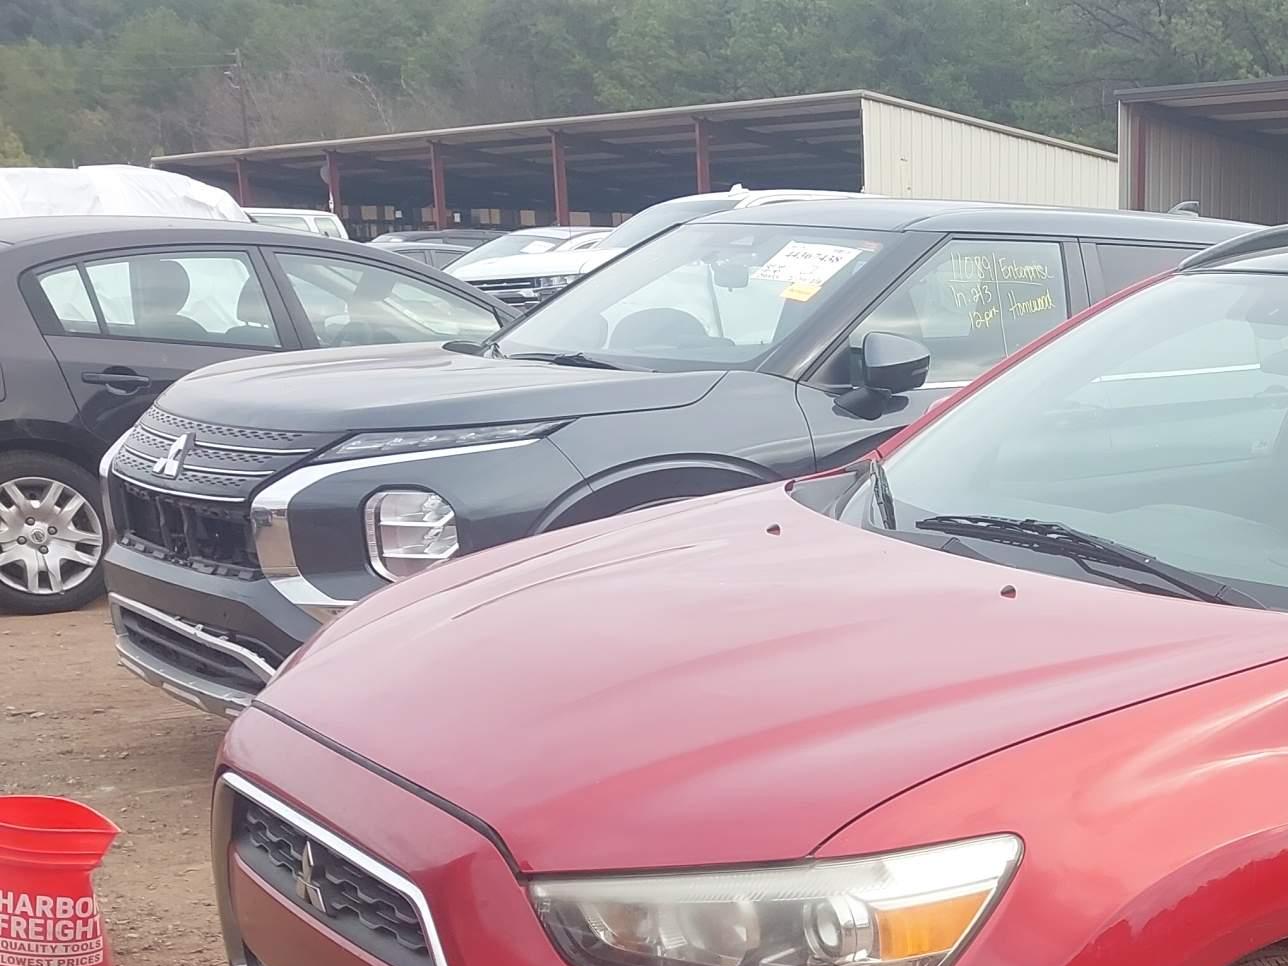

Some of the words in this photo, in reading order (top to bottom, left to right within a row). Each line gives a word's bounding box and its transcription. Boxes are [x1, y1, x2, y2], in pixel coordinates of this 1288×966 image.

[1, 940, 58, 953] QUALITY
[62, 940, 101, 953] TOOLS
[57, 954, 101, 966] PRICES
